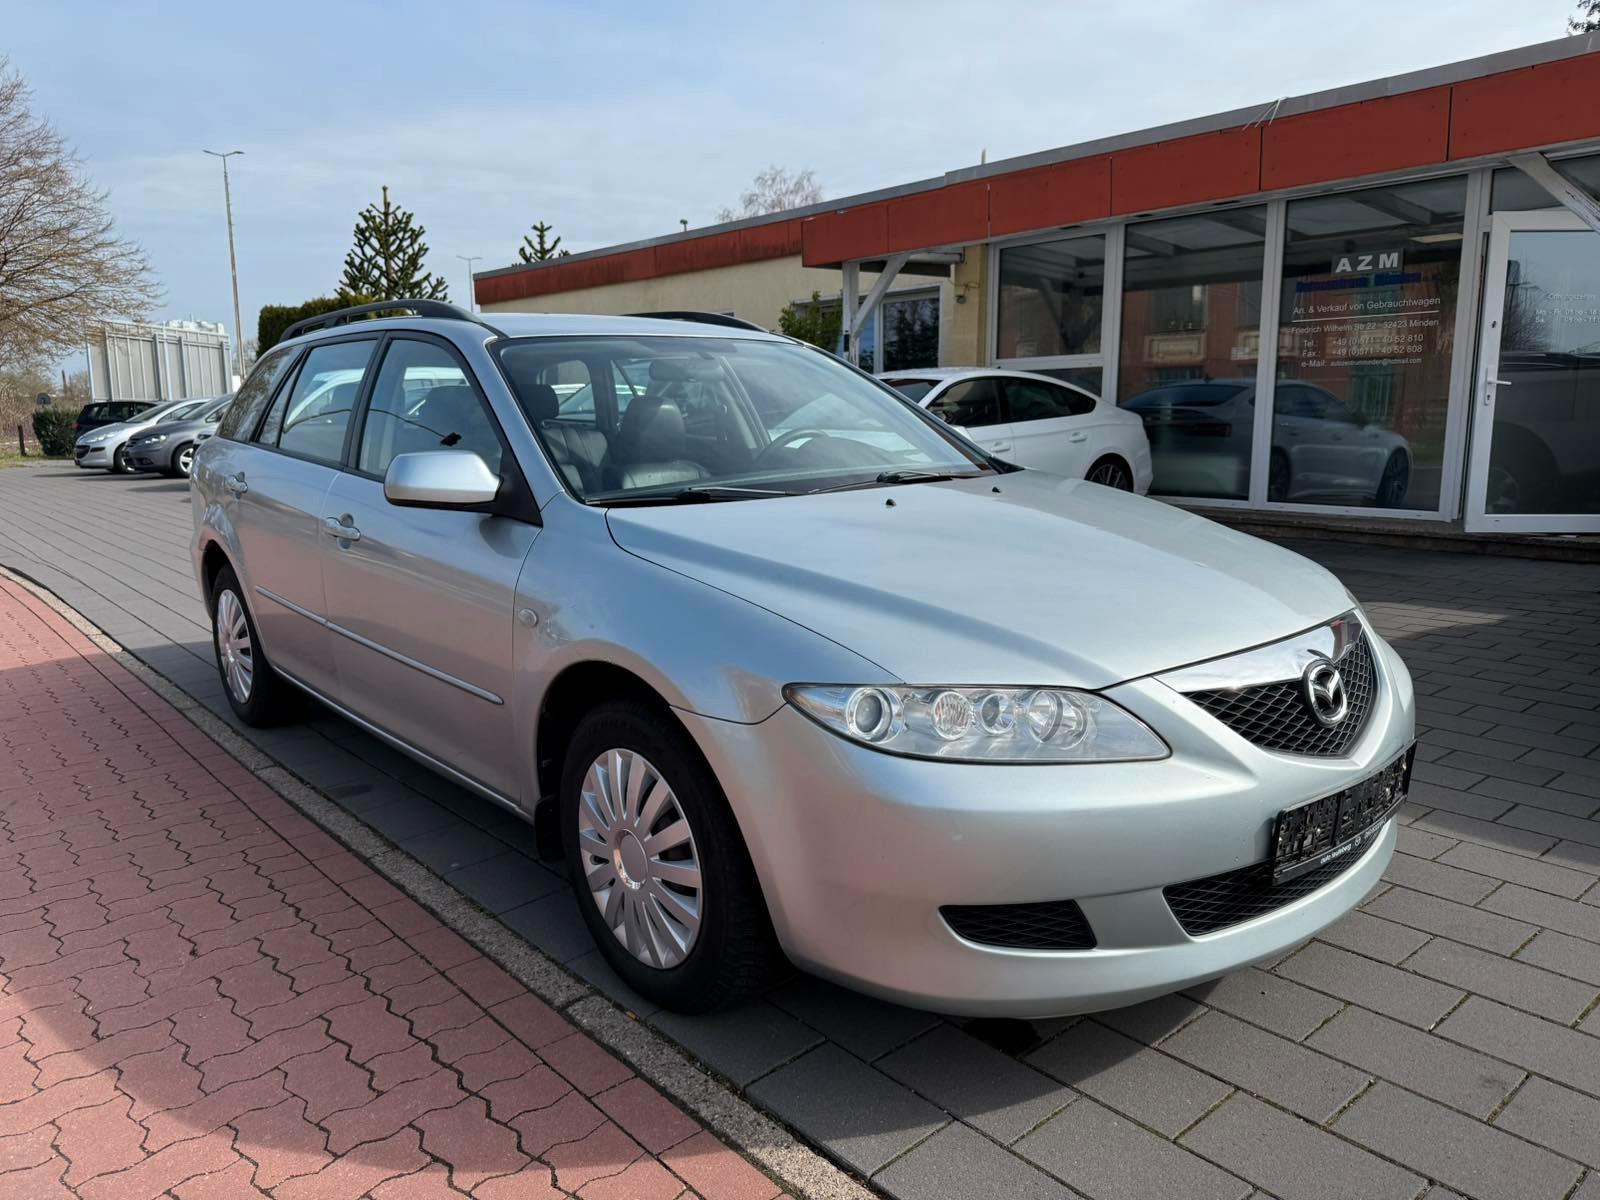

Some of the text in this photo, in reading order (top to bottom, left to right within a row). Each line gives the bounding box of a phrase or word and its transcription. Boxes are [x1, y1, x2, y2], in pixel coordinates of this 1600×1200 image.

[1317, 303, 1347, 313] Verkauf
[1349, 303, 1364, 311] von
[1366, 297, 1441, 309] Gebrauchtwagen
[1409, 319, 1439, 328] Minden
[1407, 333, 1424, 342] 810
